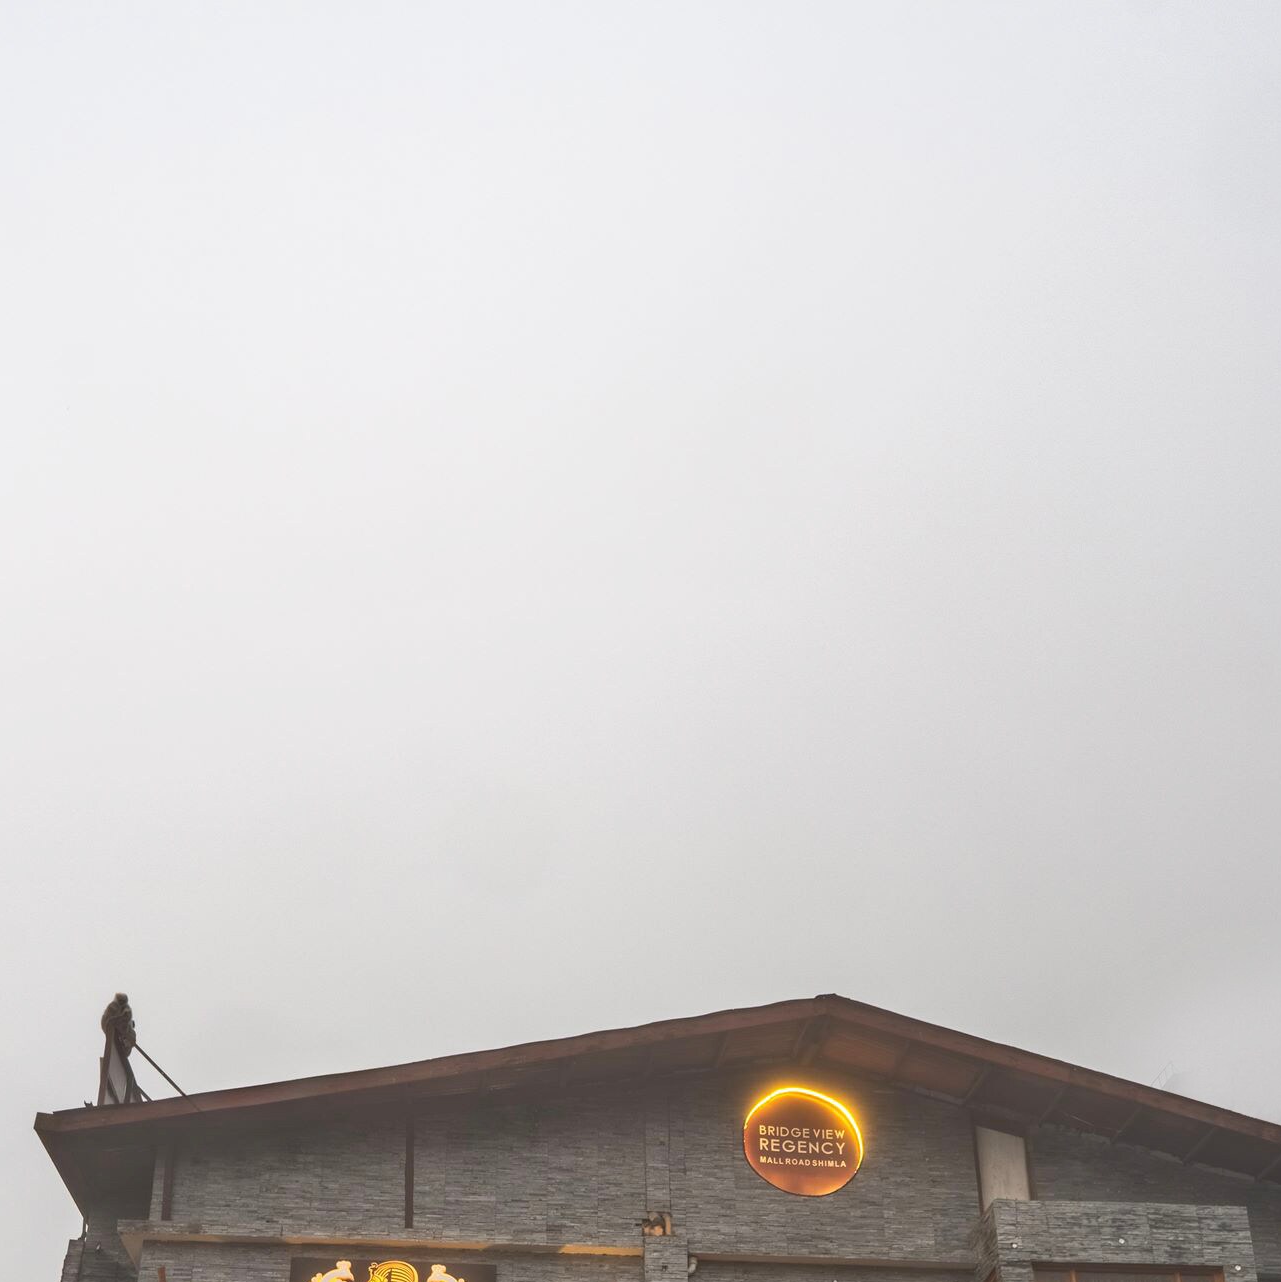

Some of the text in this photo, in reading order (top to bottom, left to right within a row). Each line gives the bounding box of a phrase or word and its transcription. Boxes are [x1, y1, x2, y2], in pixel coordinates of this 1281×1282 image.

[759, 1125, 845, 1140] BRIDGE VIEW
[759, 1138, 845, 1155] REGENCY
[759, 1156, 847, 1168] MALL ROAD SHIMLA
